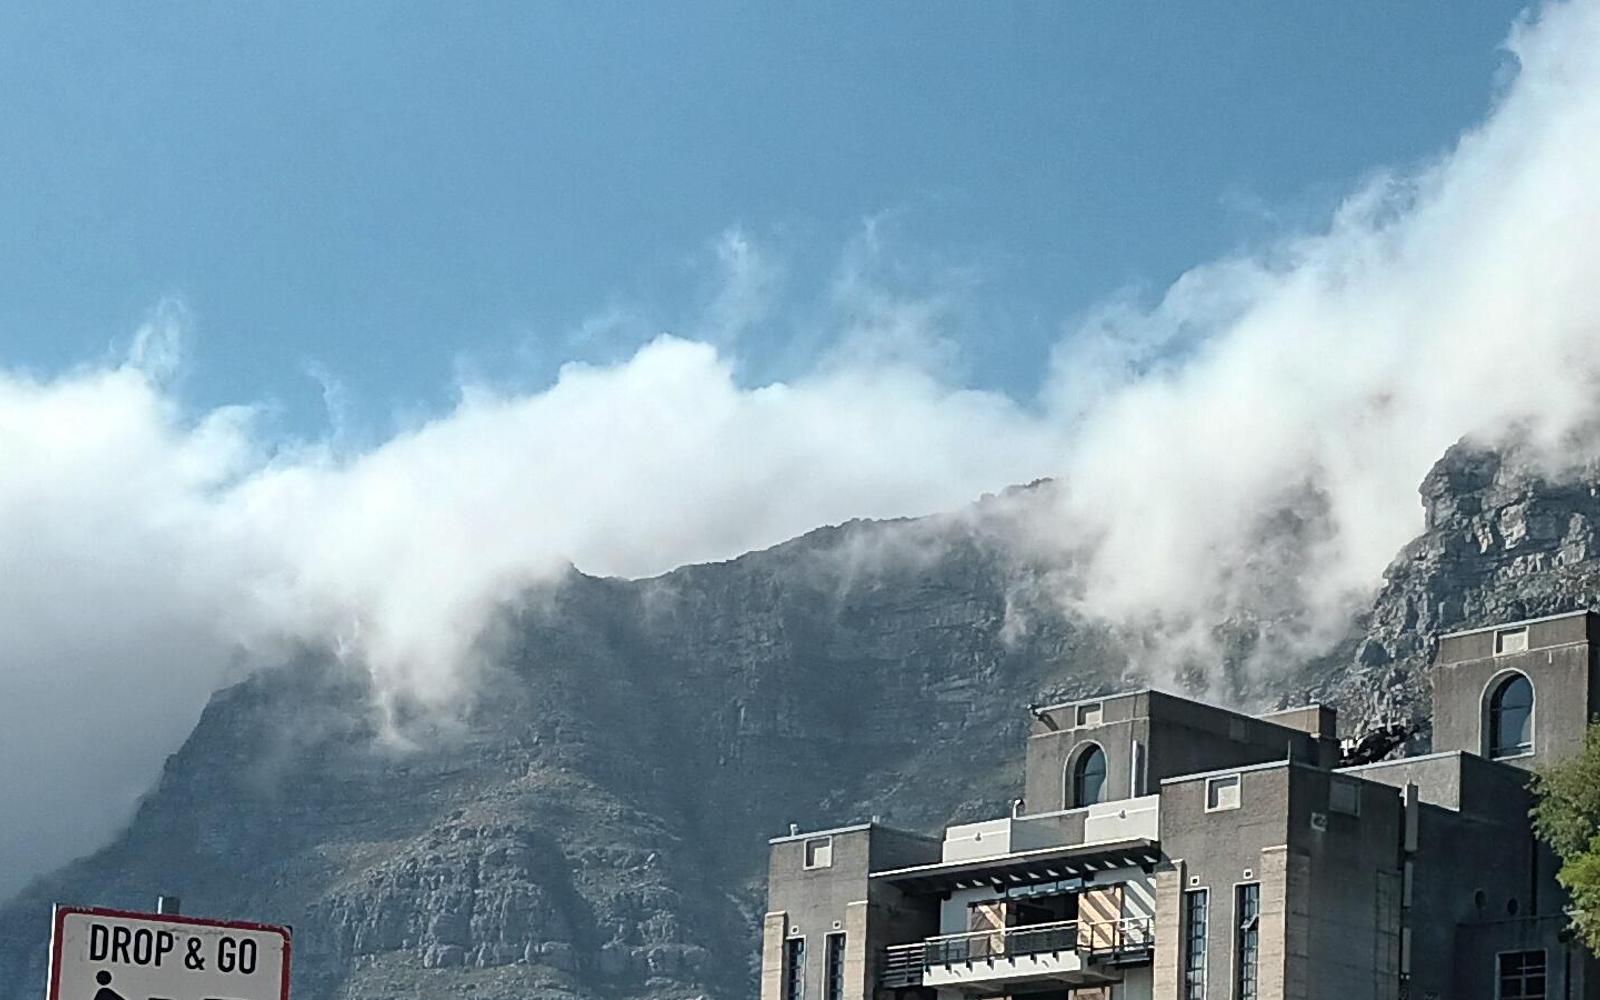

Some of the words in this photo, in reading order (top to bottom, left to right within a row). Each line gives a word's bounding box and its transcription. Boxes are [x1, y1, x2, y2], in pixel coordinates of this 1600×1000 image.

[89, 923, 174, 967] DROP
[184, 937, 206, 970] &
[218, 937, 258, 974] GO
